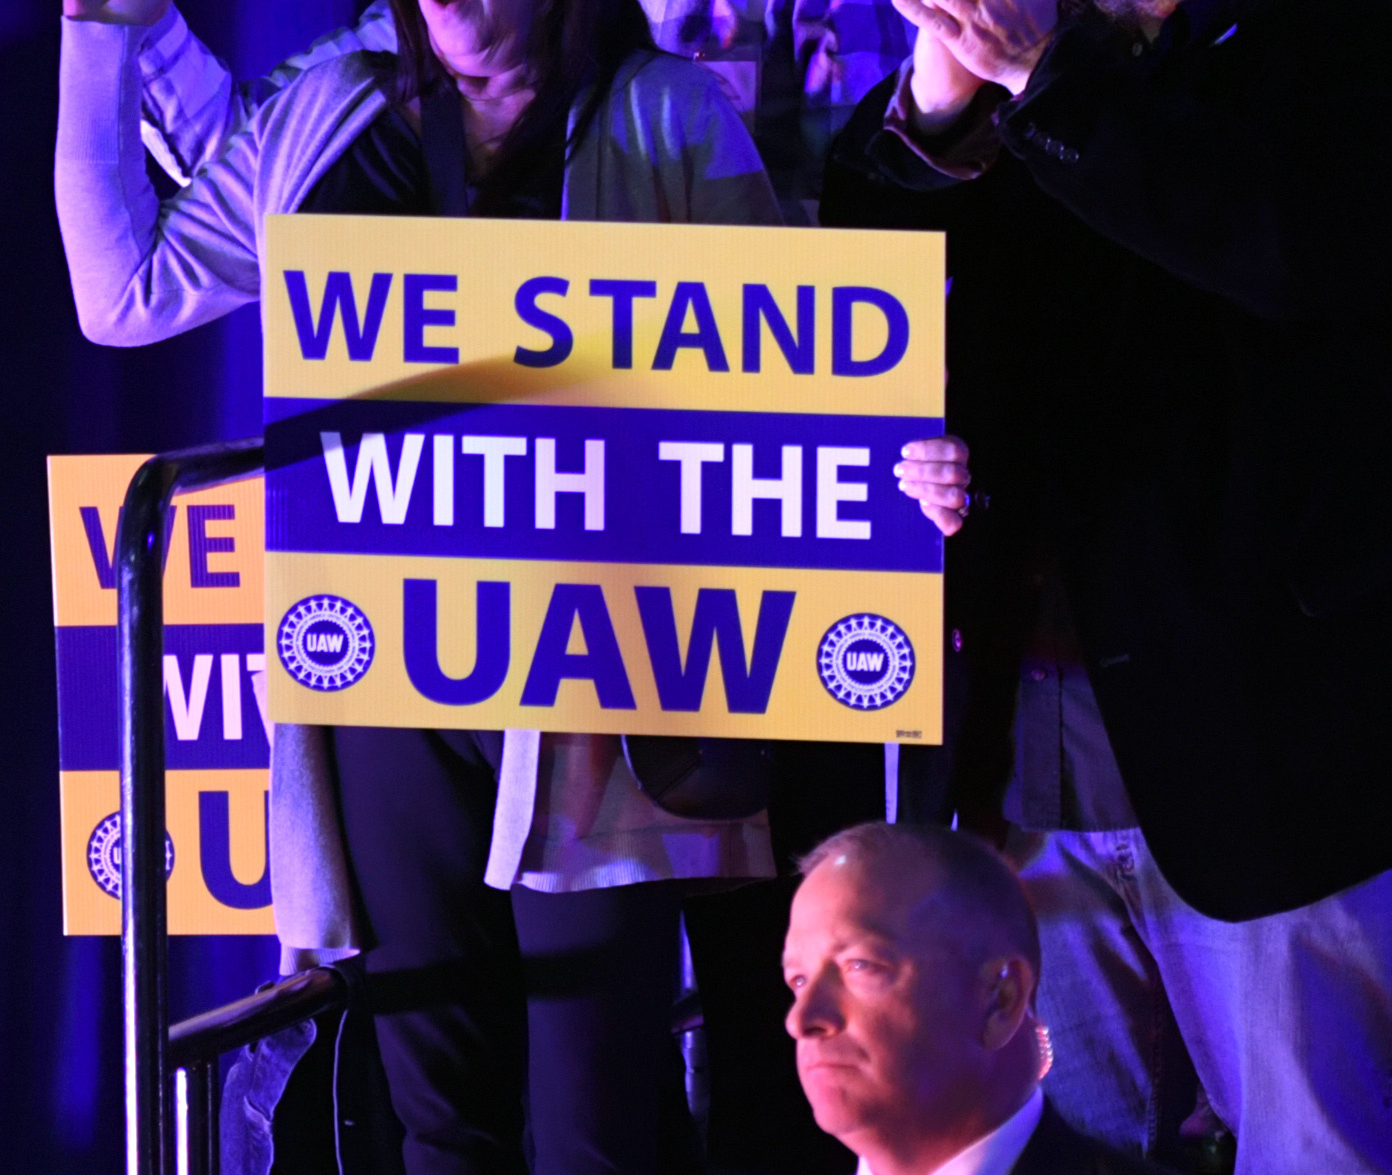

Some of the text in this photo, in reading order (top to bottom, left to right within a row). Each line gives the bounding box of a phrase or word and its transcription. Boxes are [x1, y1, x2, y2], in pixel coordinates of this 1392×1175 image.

[282, 268, 911, 378] WE STAND
[319, 431, 873, 541] WITH THE
[306, 633, 344, 654] UAW
[403, 577, 798, 715] UAW
[846, 651, 885, 672] UAW
